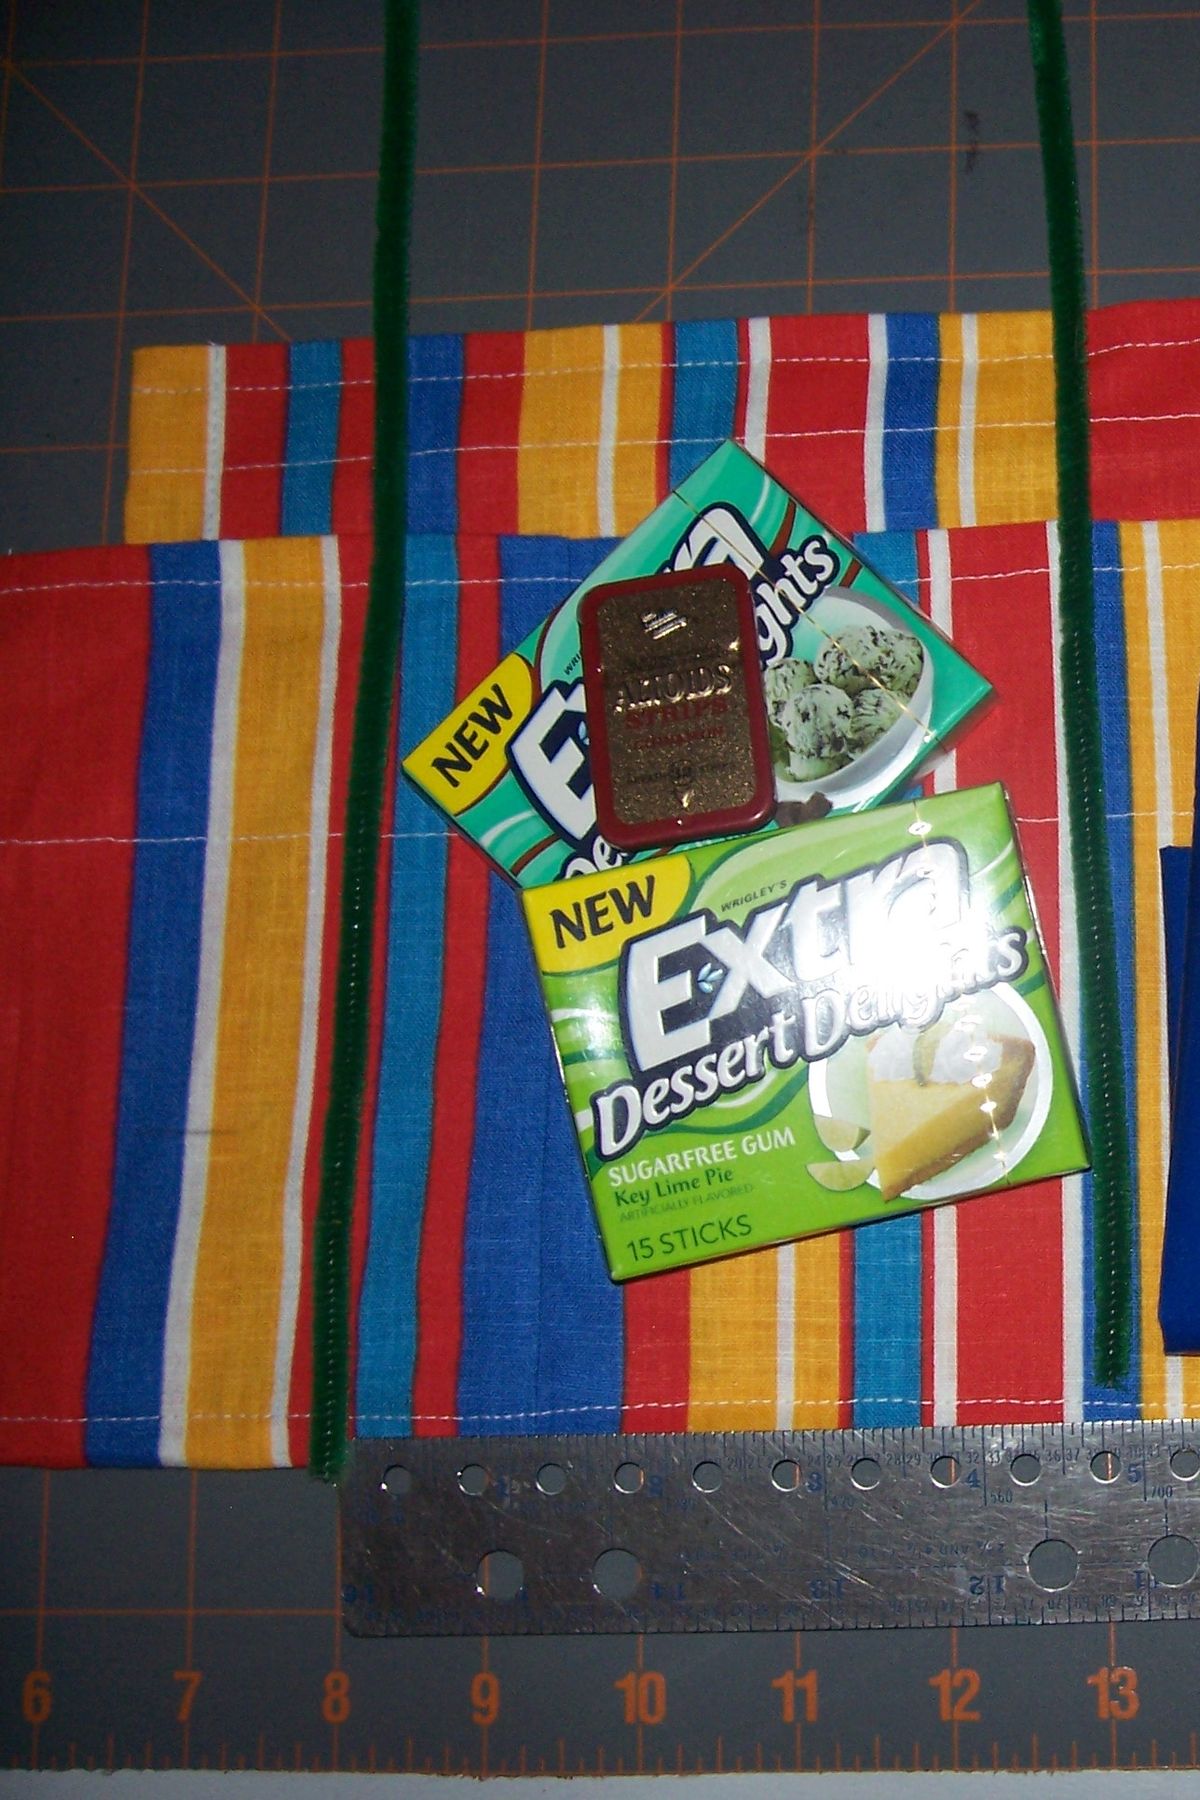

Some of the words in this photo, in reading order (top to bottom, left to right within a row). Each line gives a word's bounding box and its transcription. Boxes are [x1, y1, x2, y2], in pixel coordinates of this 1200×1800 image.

[755, 540, 834, 668] ghts
[431, 683, 513, 788] NEW
[549, 875, 655, 949] NEW
[720, 880, 787, 913] WRIGLEY'S
[628, 838, 968, 1073] Extra
[597, 1010, 798, 1157] Dessert
[800, 930, 1027, 1060] Delights
[609, 1139, 737, 1187] SUGARFREE
[741, 1126, 797, 1156] GUM
[615, 1188, 650, 1207] Key
[656, 1176, 701, 1198] Lime
[705, 1167, 734, 1187] Pie
[627, 1238, 654, 1262] 15
[659, 1214, 752, 1255] STICKS
[963, 1467, 982, 1489] 4
[1126, 1462, 1143, 1484] 5
[968, 1574, 1006, 1596] 12
[22, 1671, 51, 1722] 6
[173, 1671, 201, 1722] 7
[323, 1671, 350, 1723] 8
[470, 1672, 499, 1724] 9
[614, 1672, 667, 1724] 10
[771, 1670, 818, 1723] 11
[929, 1669, 981, 1721] 12
[1086, 1666, 1140, 1719] 13
